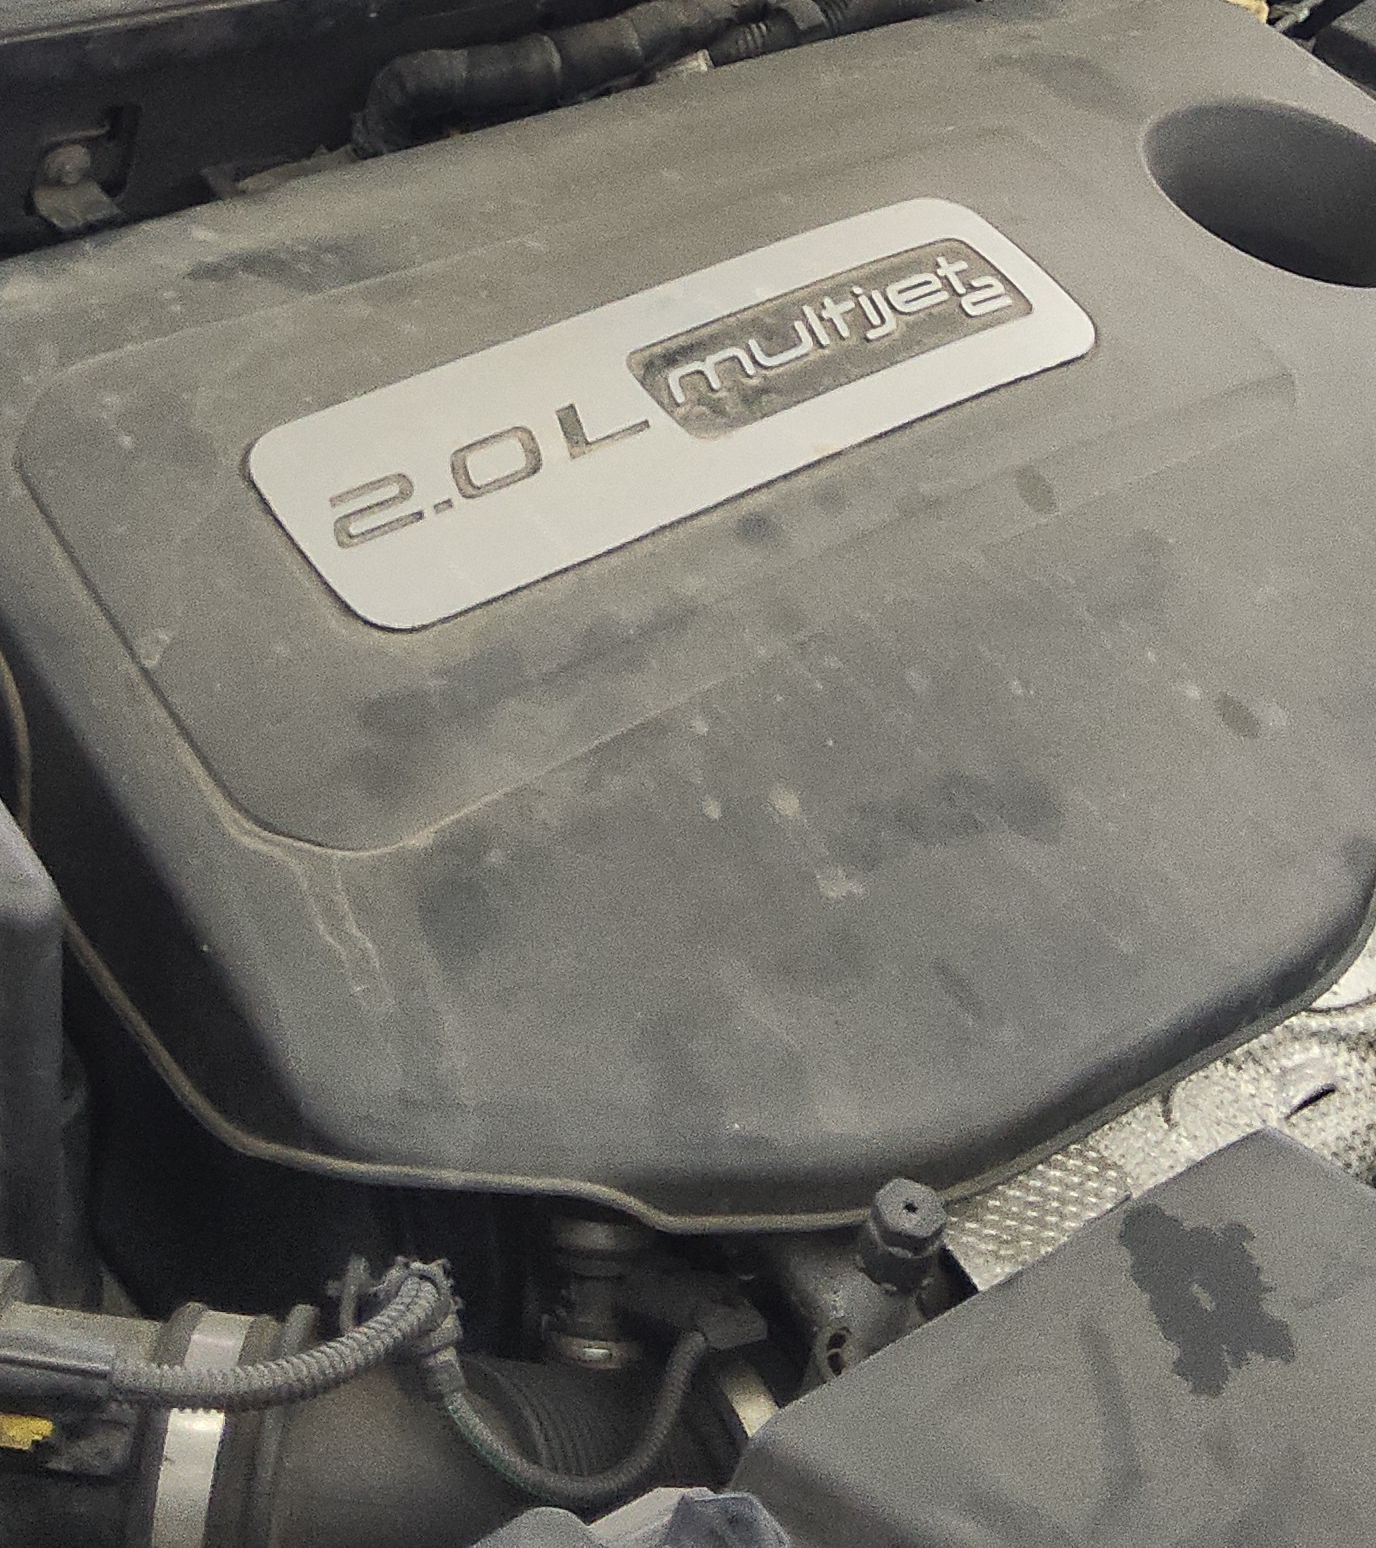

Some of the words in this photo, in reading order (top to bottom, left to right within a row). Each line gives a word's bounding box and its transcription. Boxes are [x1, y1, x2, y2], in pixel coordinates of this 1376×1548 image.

[328, 424, 544, 549] 2.0
[555, 402, 652, 458] L
[665, 253, 971, 408] multijet
